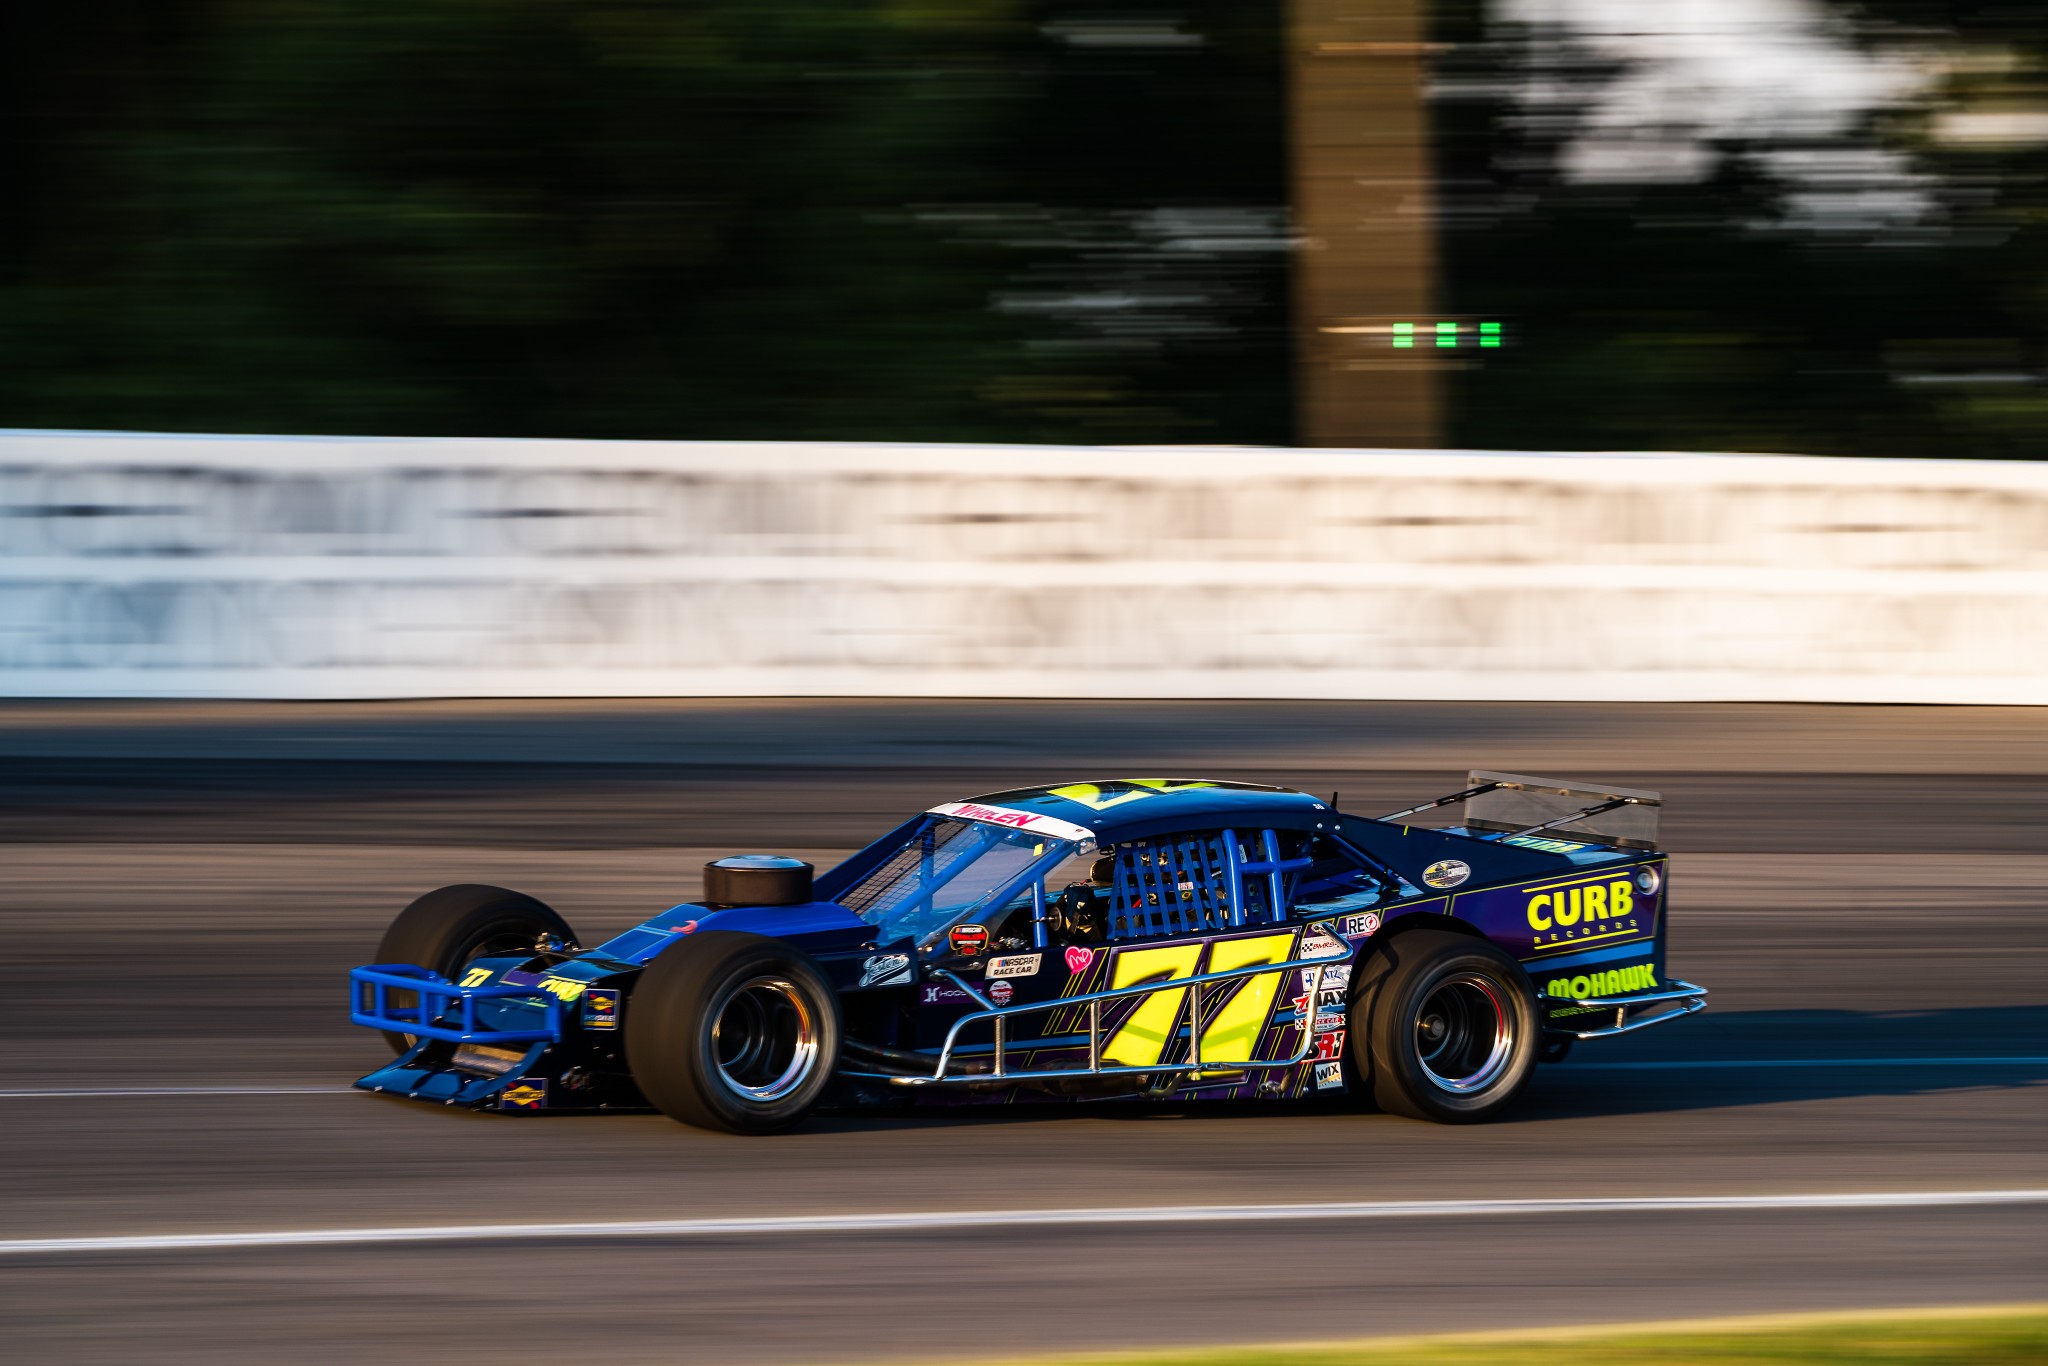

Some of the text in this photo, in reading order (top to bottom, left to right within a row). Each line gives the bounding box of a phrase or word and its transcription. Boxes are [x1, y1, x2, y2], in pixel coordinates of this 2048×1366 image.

[951, 804, 1044, 827] WHELEN
[1527, 880, 1634, 931] CURB
[1533, 919, 1638, 944] RECORDS
[993, 966, 1032, 976] RACE CAR
[1004, 956, 1035, 967] NASCAR
[458, 967, 494, 987] 77
[1547, 963, 1659, 1000] MOHAWK
[1101, 933, 1296, 1078] 77
[1316, 1063, 1340, 1081] WIX
